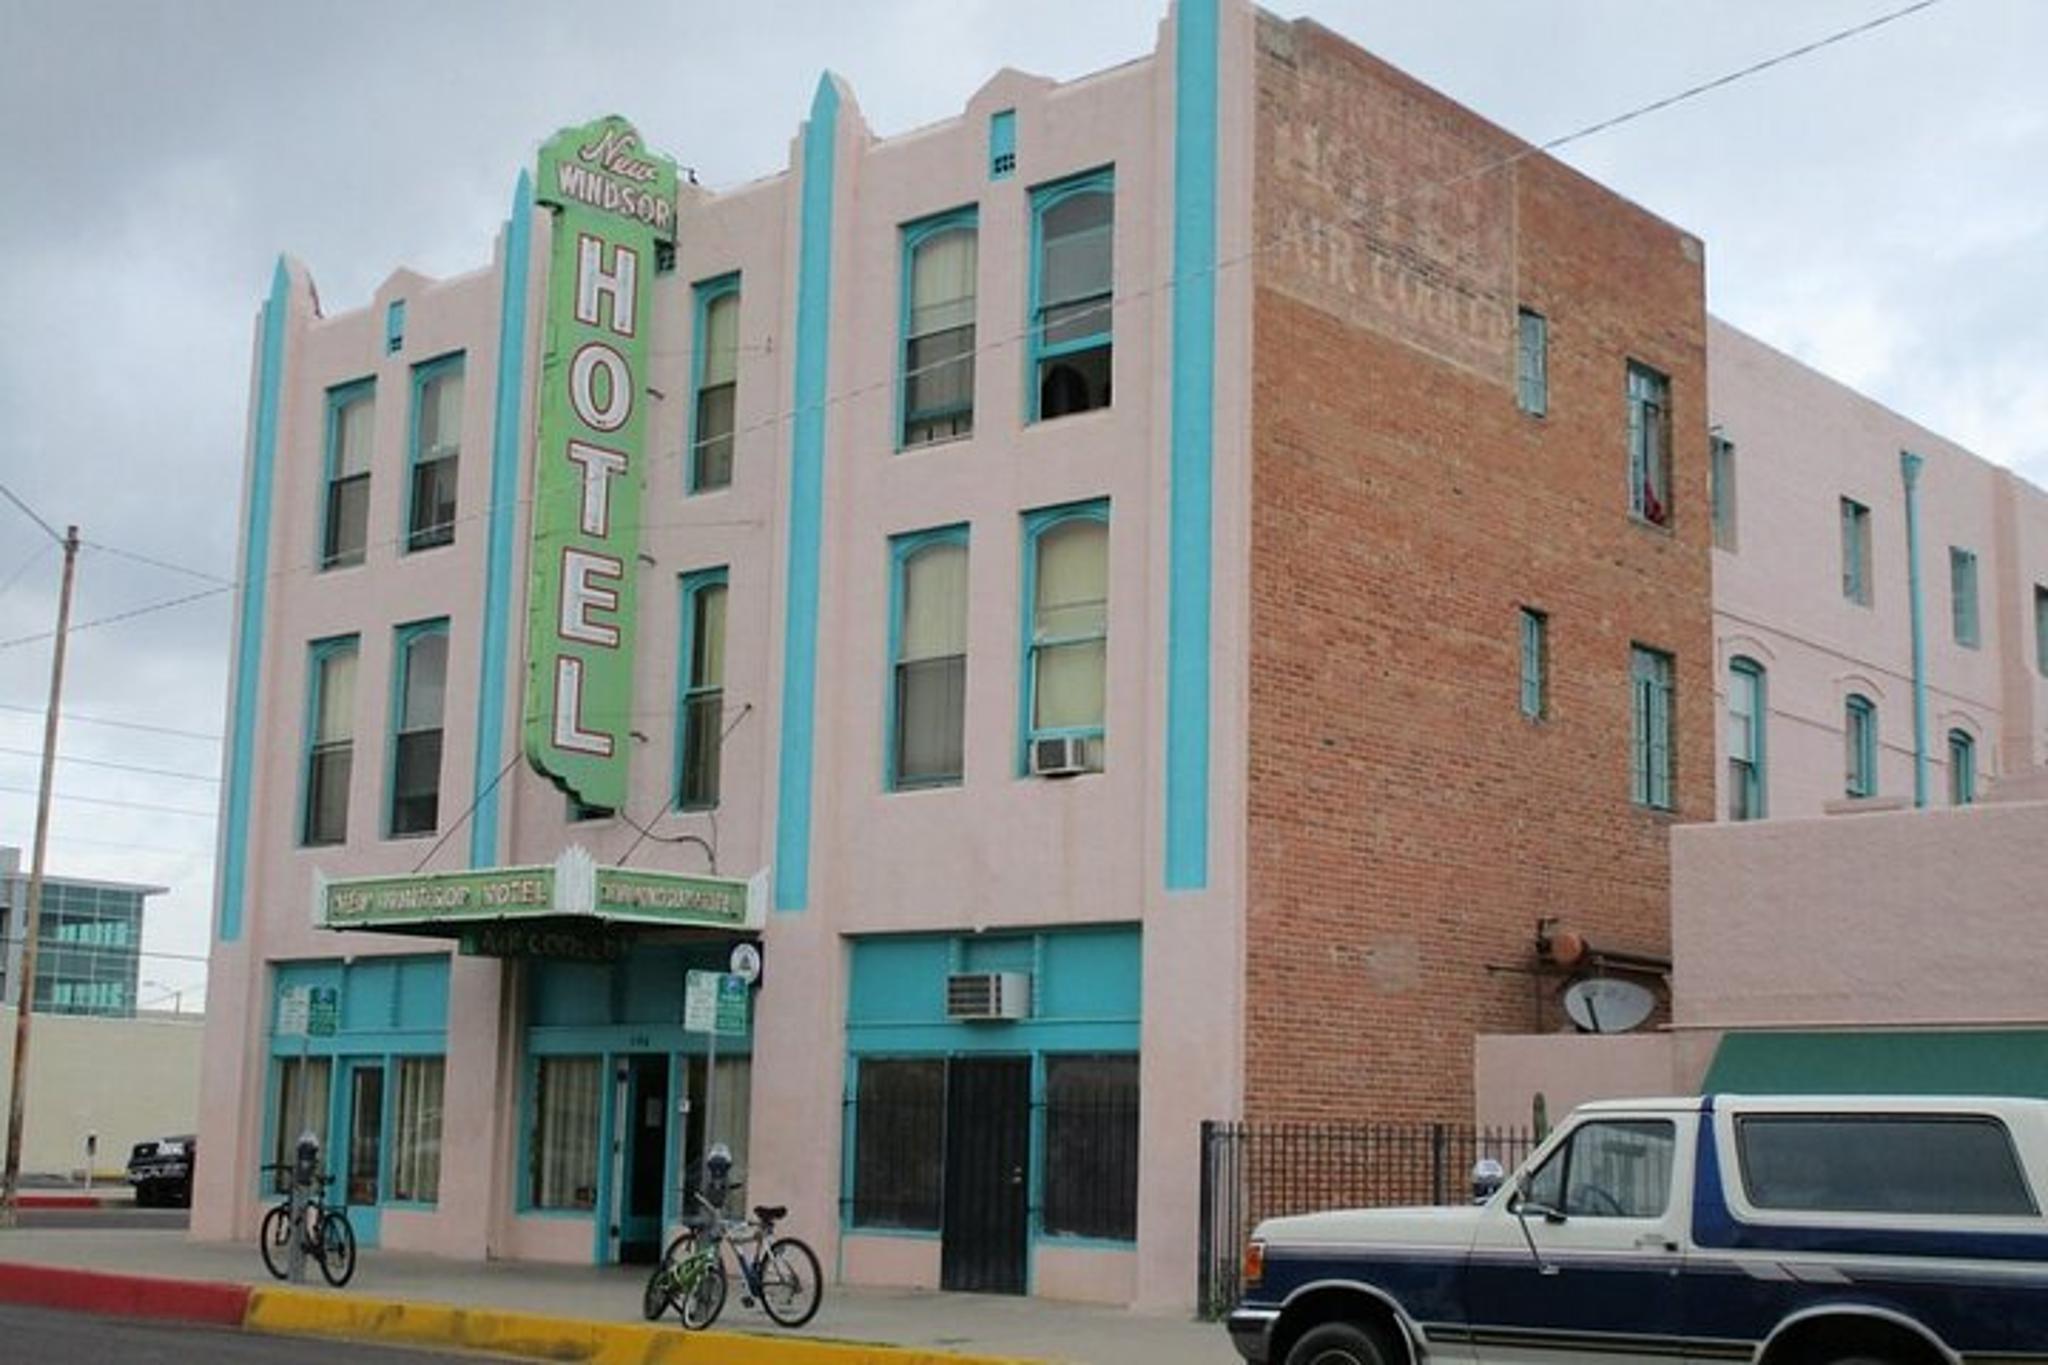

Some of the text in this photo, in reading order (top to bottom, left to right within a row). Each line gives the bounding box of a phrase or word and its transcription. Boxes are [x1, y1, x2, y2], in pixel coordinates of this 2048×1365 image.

[577, 125, 659, 182] New
[557, 161, 670, 229] WINDSOR
[552, 234, 637, 757] HOTEL
[481, 880, 548, 907] HOTEL
